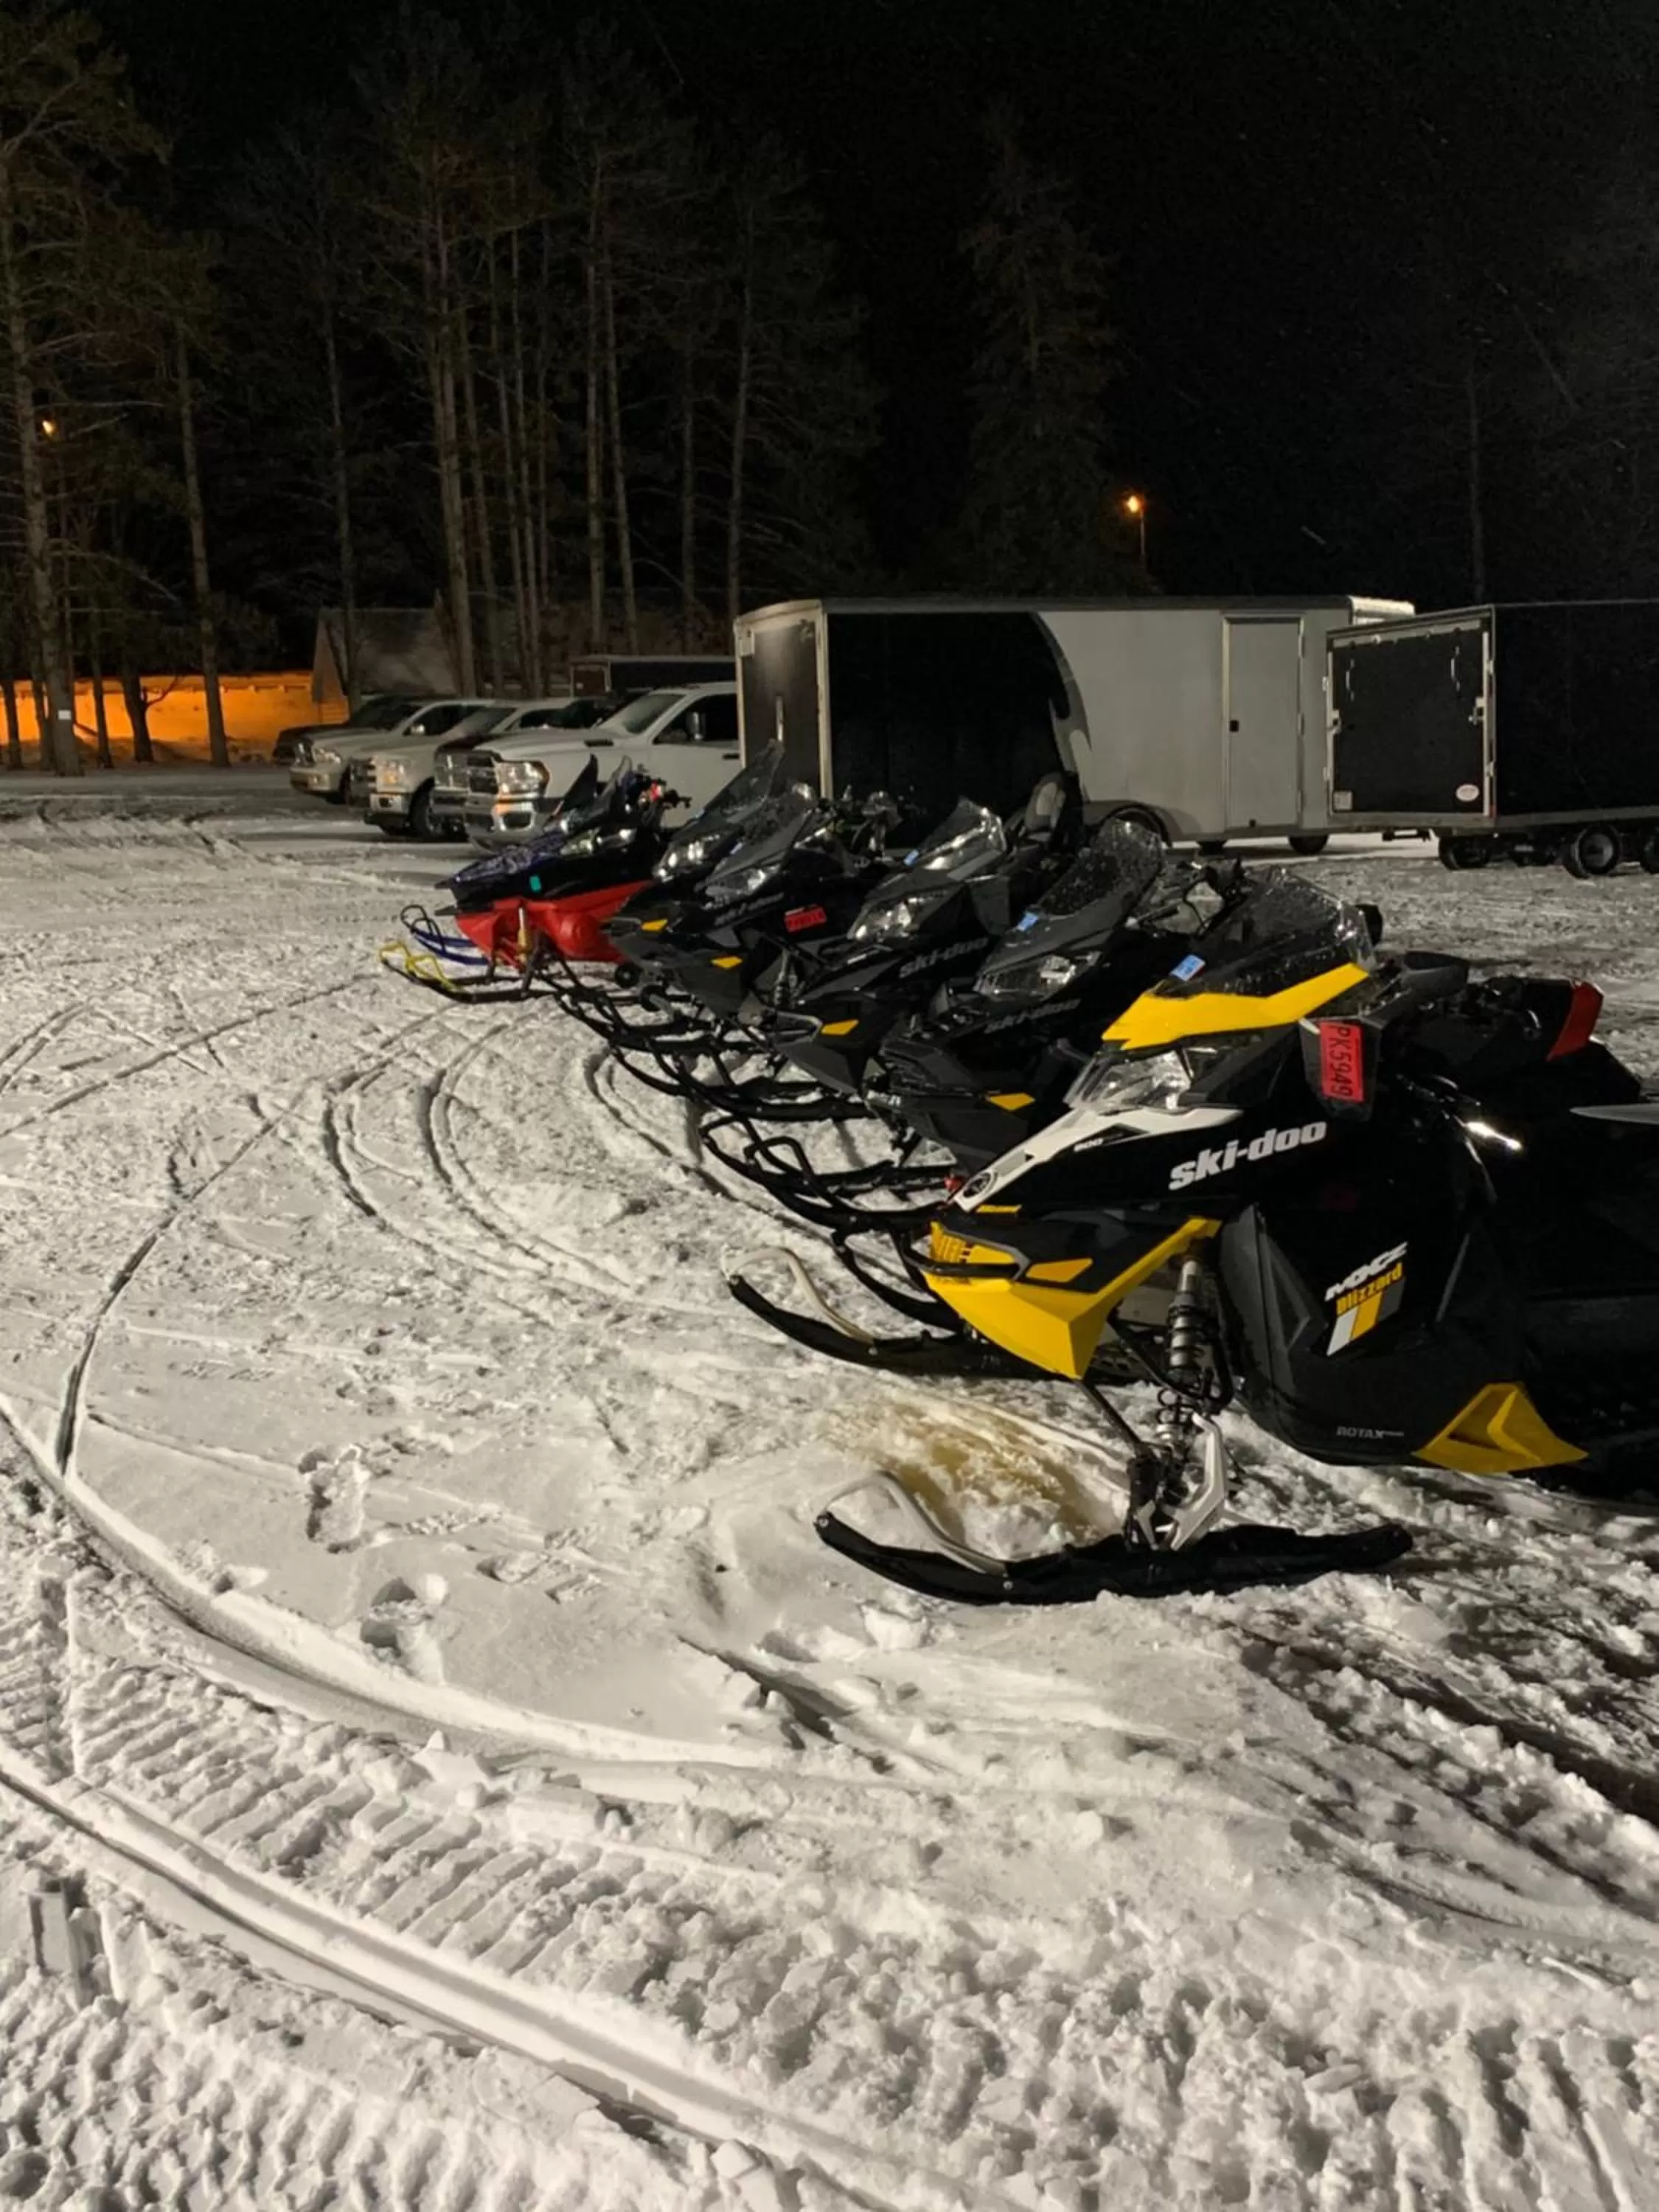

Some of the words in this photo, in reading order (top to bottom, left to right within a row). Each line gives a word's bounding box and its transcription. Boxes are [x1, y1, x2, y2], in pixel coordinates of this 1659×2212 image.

[1329, 1025, 1353, 1096] PK5949
[1169, 1121, 1326, 1190] ski-doo
[1336, 1425, 1384, 1439] ROTAX
